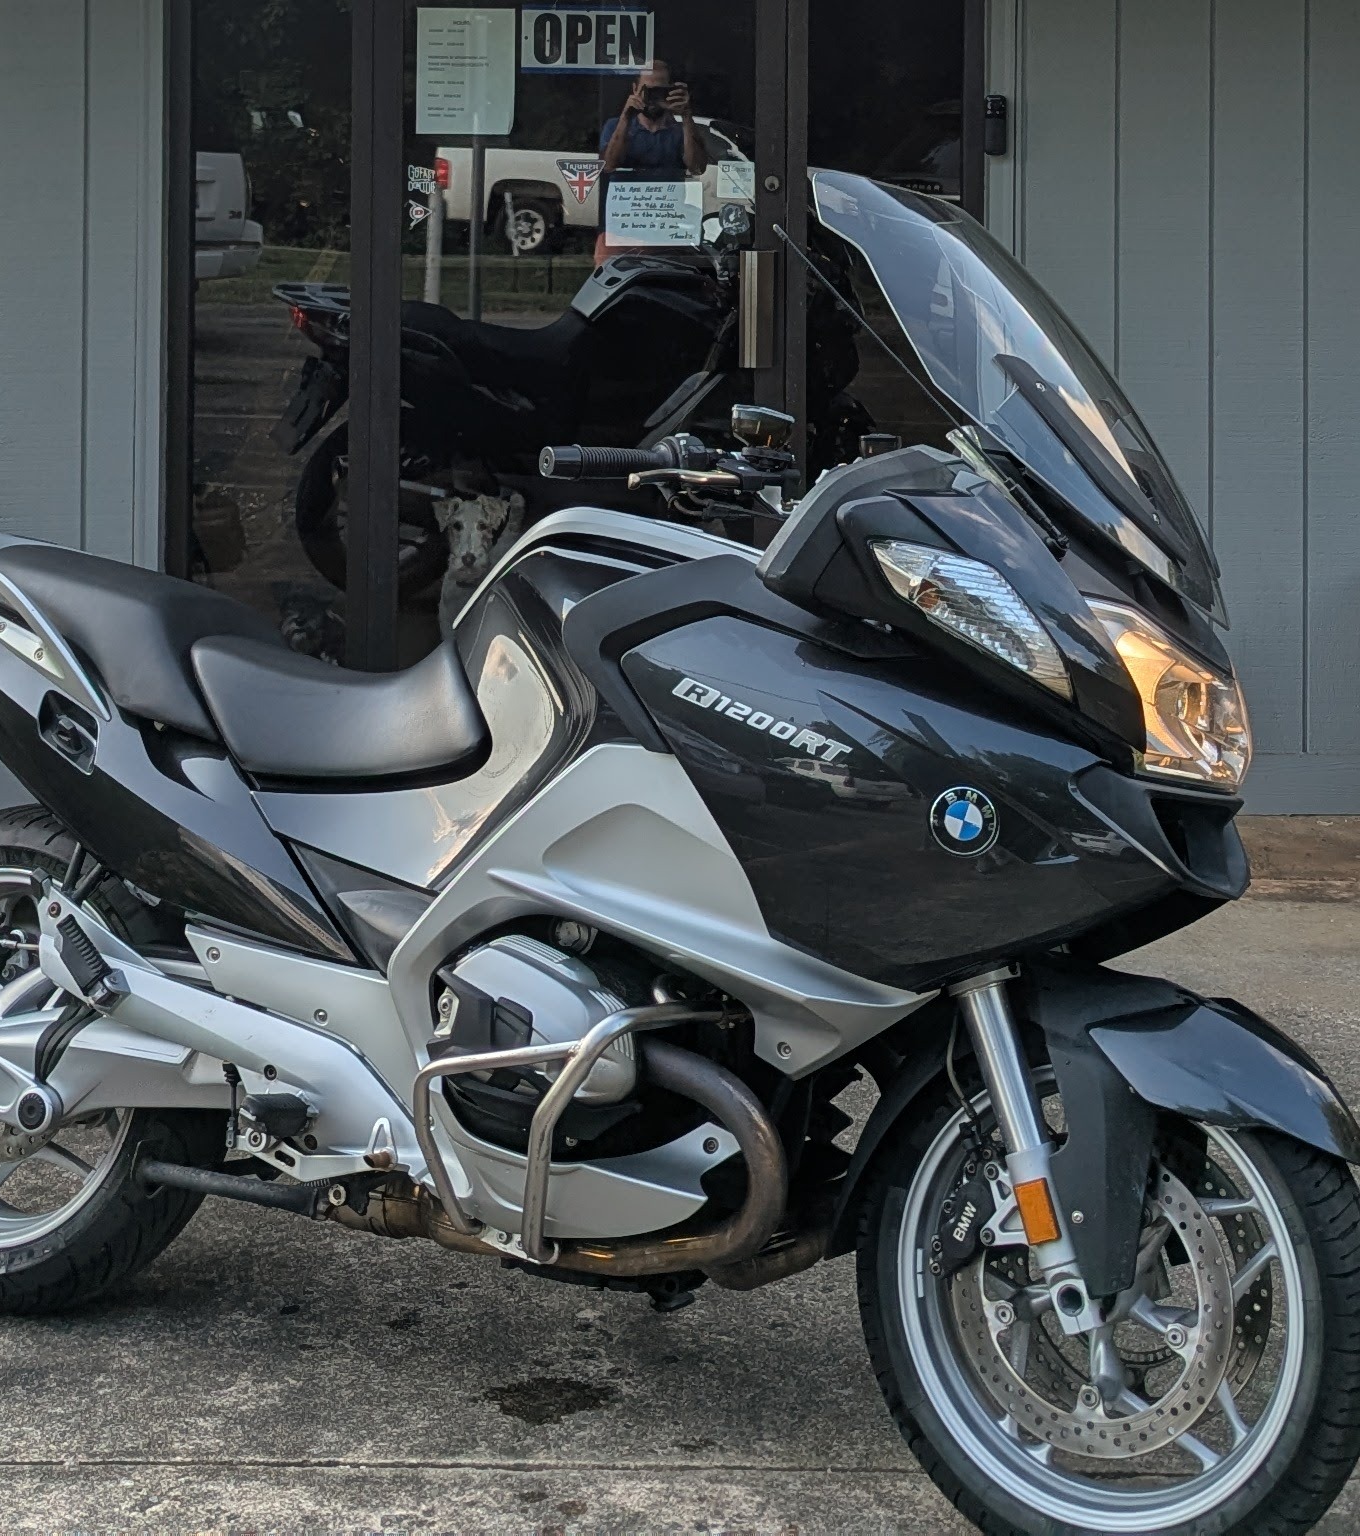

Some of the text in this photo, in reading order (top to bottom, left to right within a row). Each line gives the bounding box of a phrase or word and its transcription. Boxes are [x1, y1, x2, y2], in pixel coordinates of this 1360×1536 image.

[533, 12, 647, 66] OPEN
[563, 162, 599, 170] TRIUMPH
[672, 677, 854, 762] R1200RT
[952, 1201, 977, 1242] BMW
